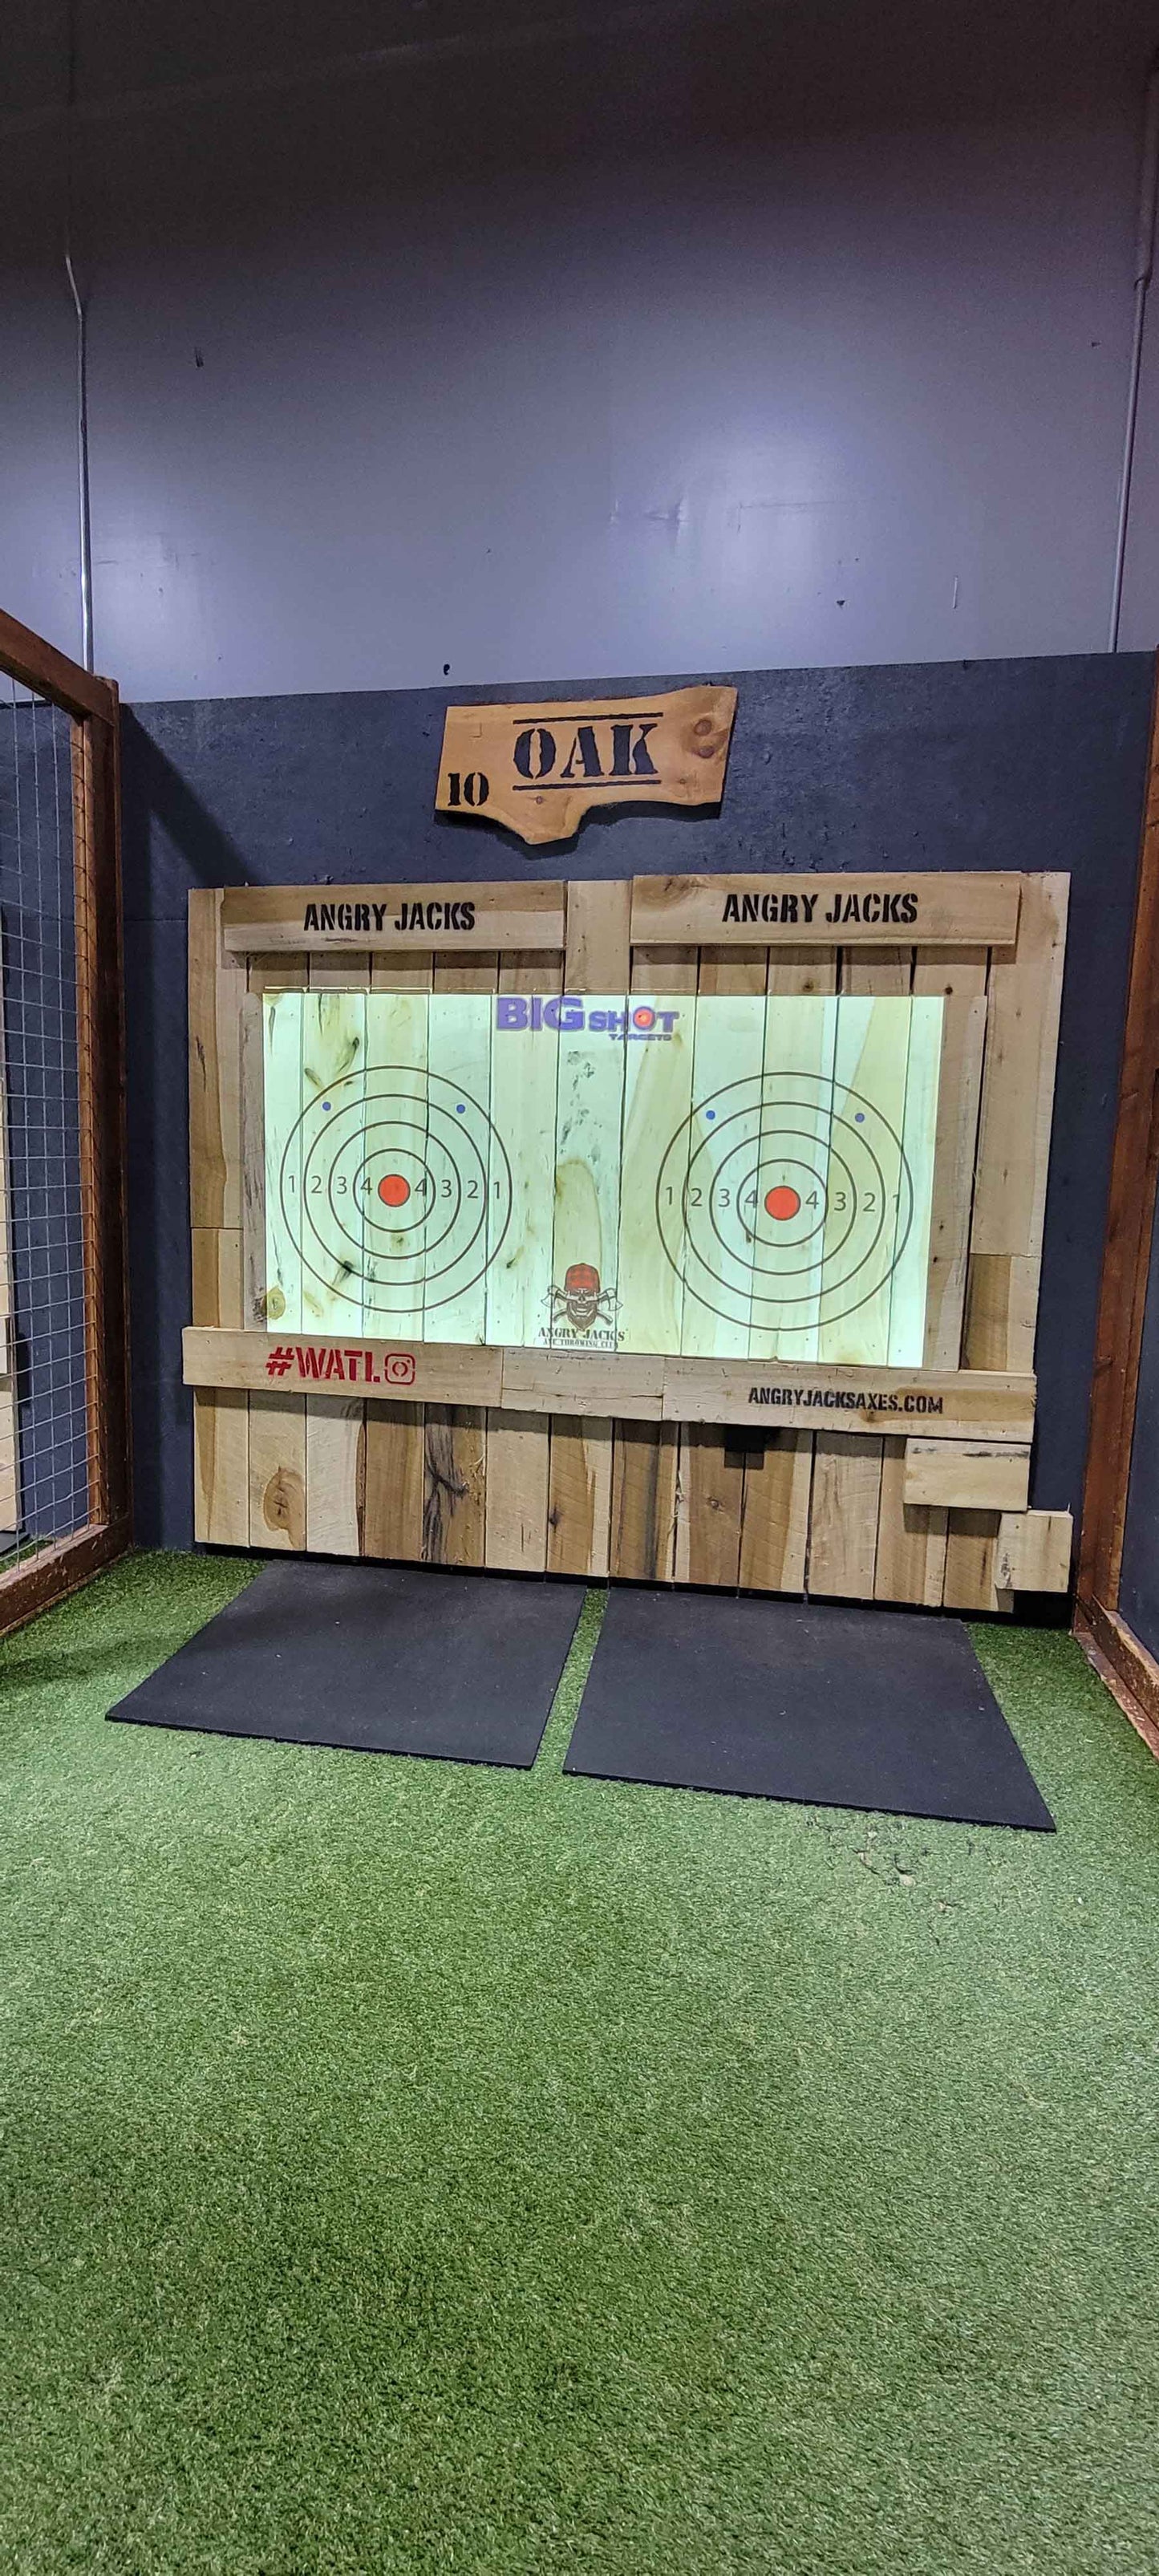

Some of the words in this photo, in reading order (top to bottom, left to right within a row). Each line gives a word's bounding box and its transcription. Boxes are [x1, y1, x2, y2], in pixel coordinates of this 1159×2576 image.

[513, 724, 659, 779] OAK
[447, 772, 489, 806] 10
[303, 903, 387, 931] ANGRY
[394, 902, 476, 931] JACKS
[722, 894, 820, 923] ANGRY
[825, 893, 918, 923] JACKS
[496, 996, 585, 1031] BIG
[589, 1006, 679, 1032] SHOT
[608, 1033, 672, 1041] TARGETS
[311, 1175, 322, 1194] 2
[336, 1176, 348, 1195] 3
[361, 1177, 373, 1195] 4
[415, 1178, 428, 1196] 4
[441, 1179, 452, 1198] 3
[467, 1180, 479, 1199] 2
[691, 1187, 703, 1207] 2
[719, 1188, 730, 1207] 3
[745, 1190, 758, 1208] 4
[805, 1191, 819, 1209] 4
[834, 1191, 846, 1211] 3
[863, 1192, 876, 1212] 2
[538, 1327, 577, 1339] ANGRY
[582, 1329, 625, 1342] JACKS
[748, 1387, 943, 1414] ANGRYJACKSAXES.COM
